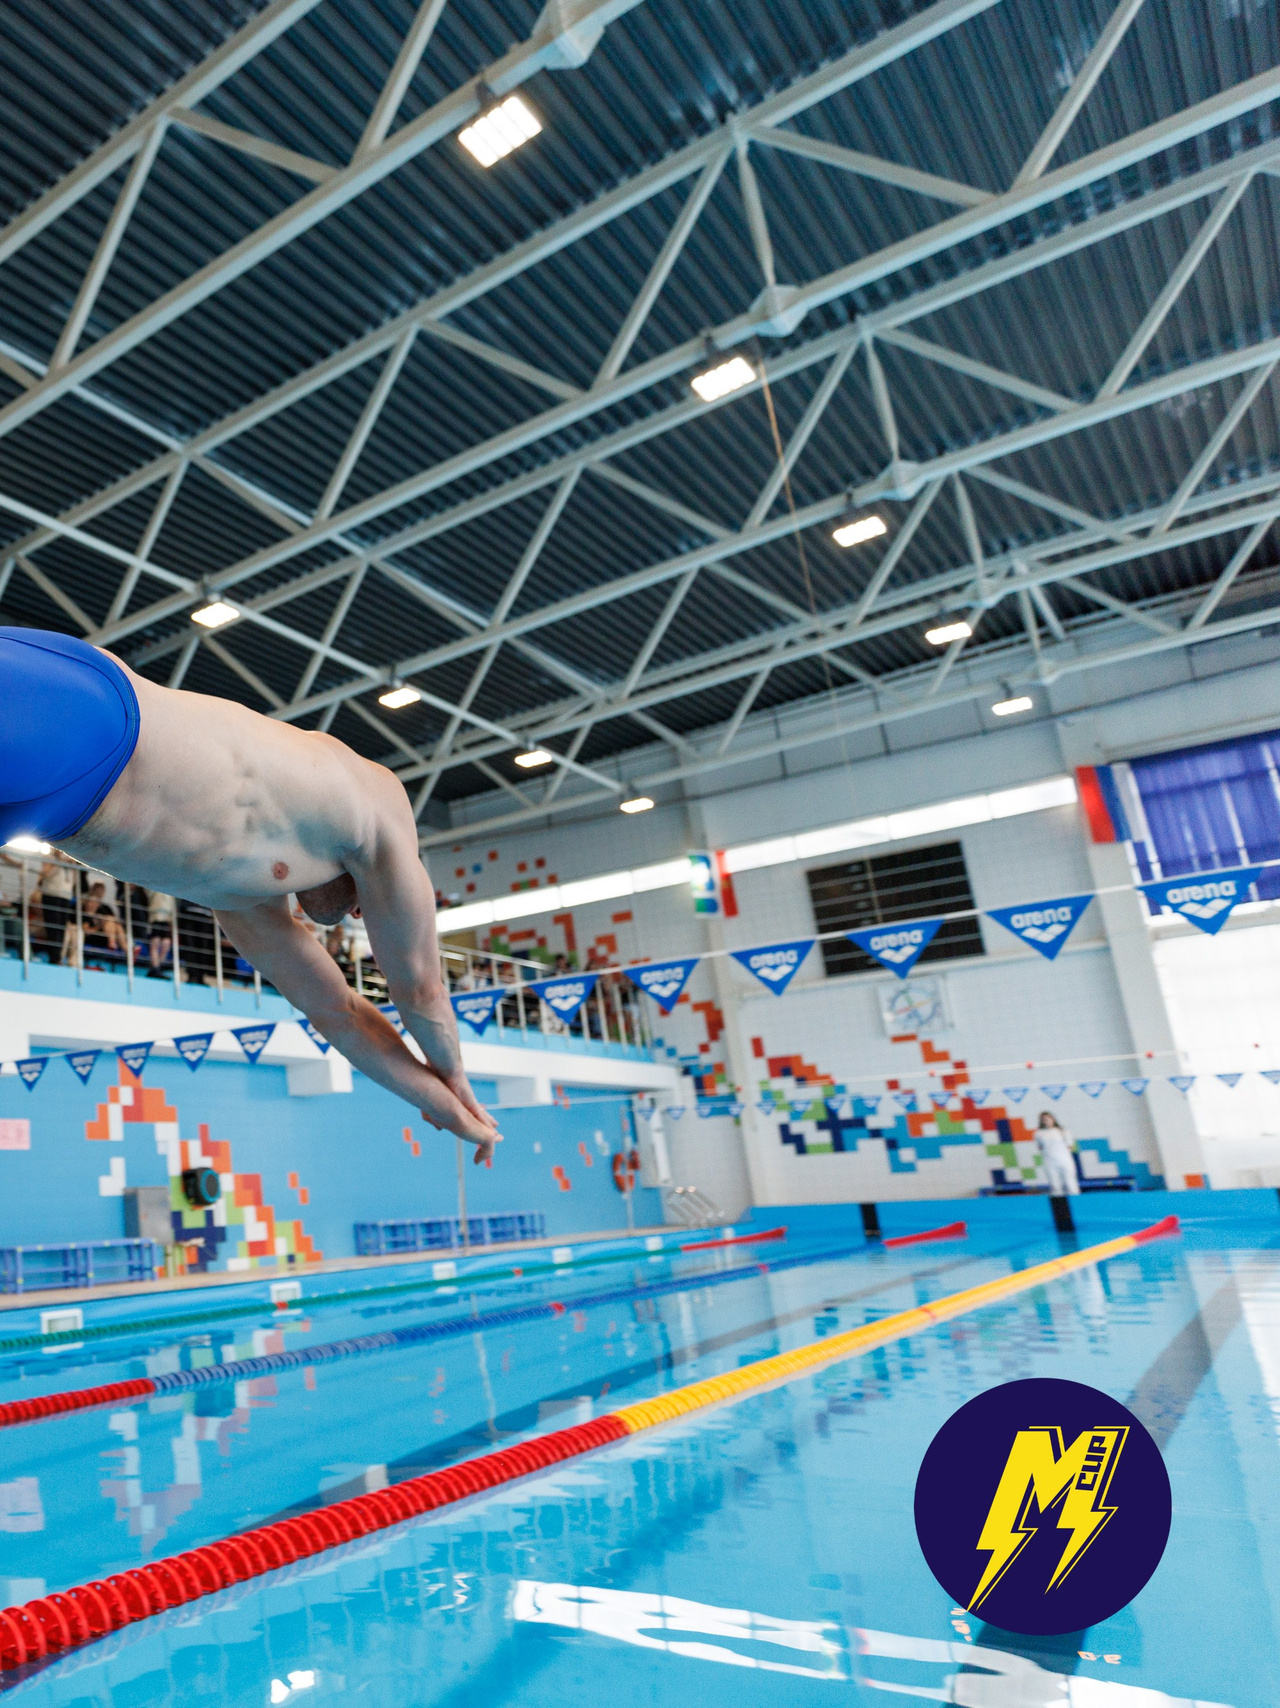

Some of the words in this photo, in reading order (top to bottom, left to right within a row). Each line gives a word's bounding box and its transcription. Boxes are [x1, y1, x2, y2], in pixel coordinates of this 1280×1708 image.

[1166, 880, 1238, 904] arena
[1010, 906, 1072, 929] arena
[870, 929, 924, 951] arena
[749, 949, 799, 969] arena
